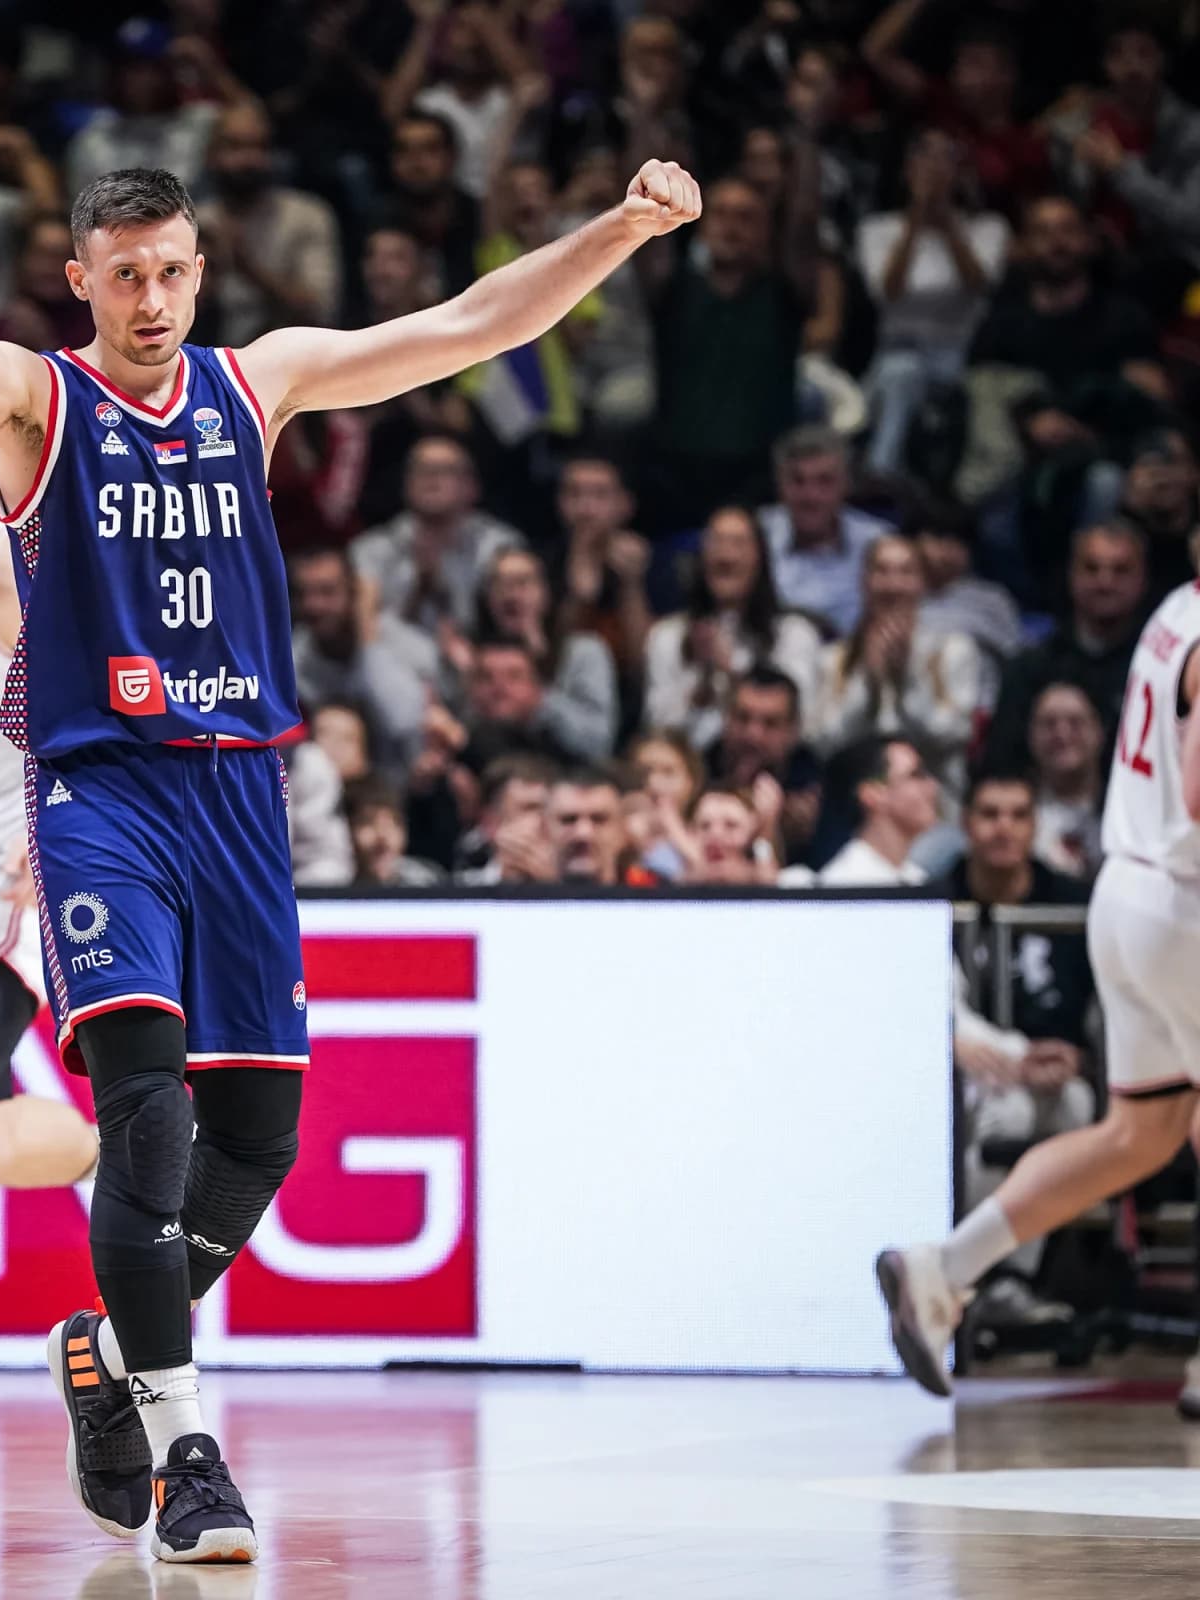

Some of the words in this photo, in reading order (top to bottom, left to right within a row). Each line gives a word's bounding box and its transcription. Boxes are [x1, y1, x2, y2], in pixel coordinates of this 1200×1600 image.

[160, 566, 212, 629] 30
[163, 666, 259, 712] triglav
[71, 948, 114, 973] mts
